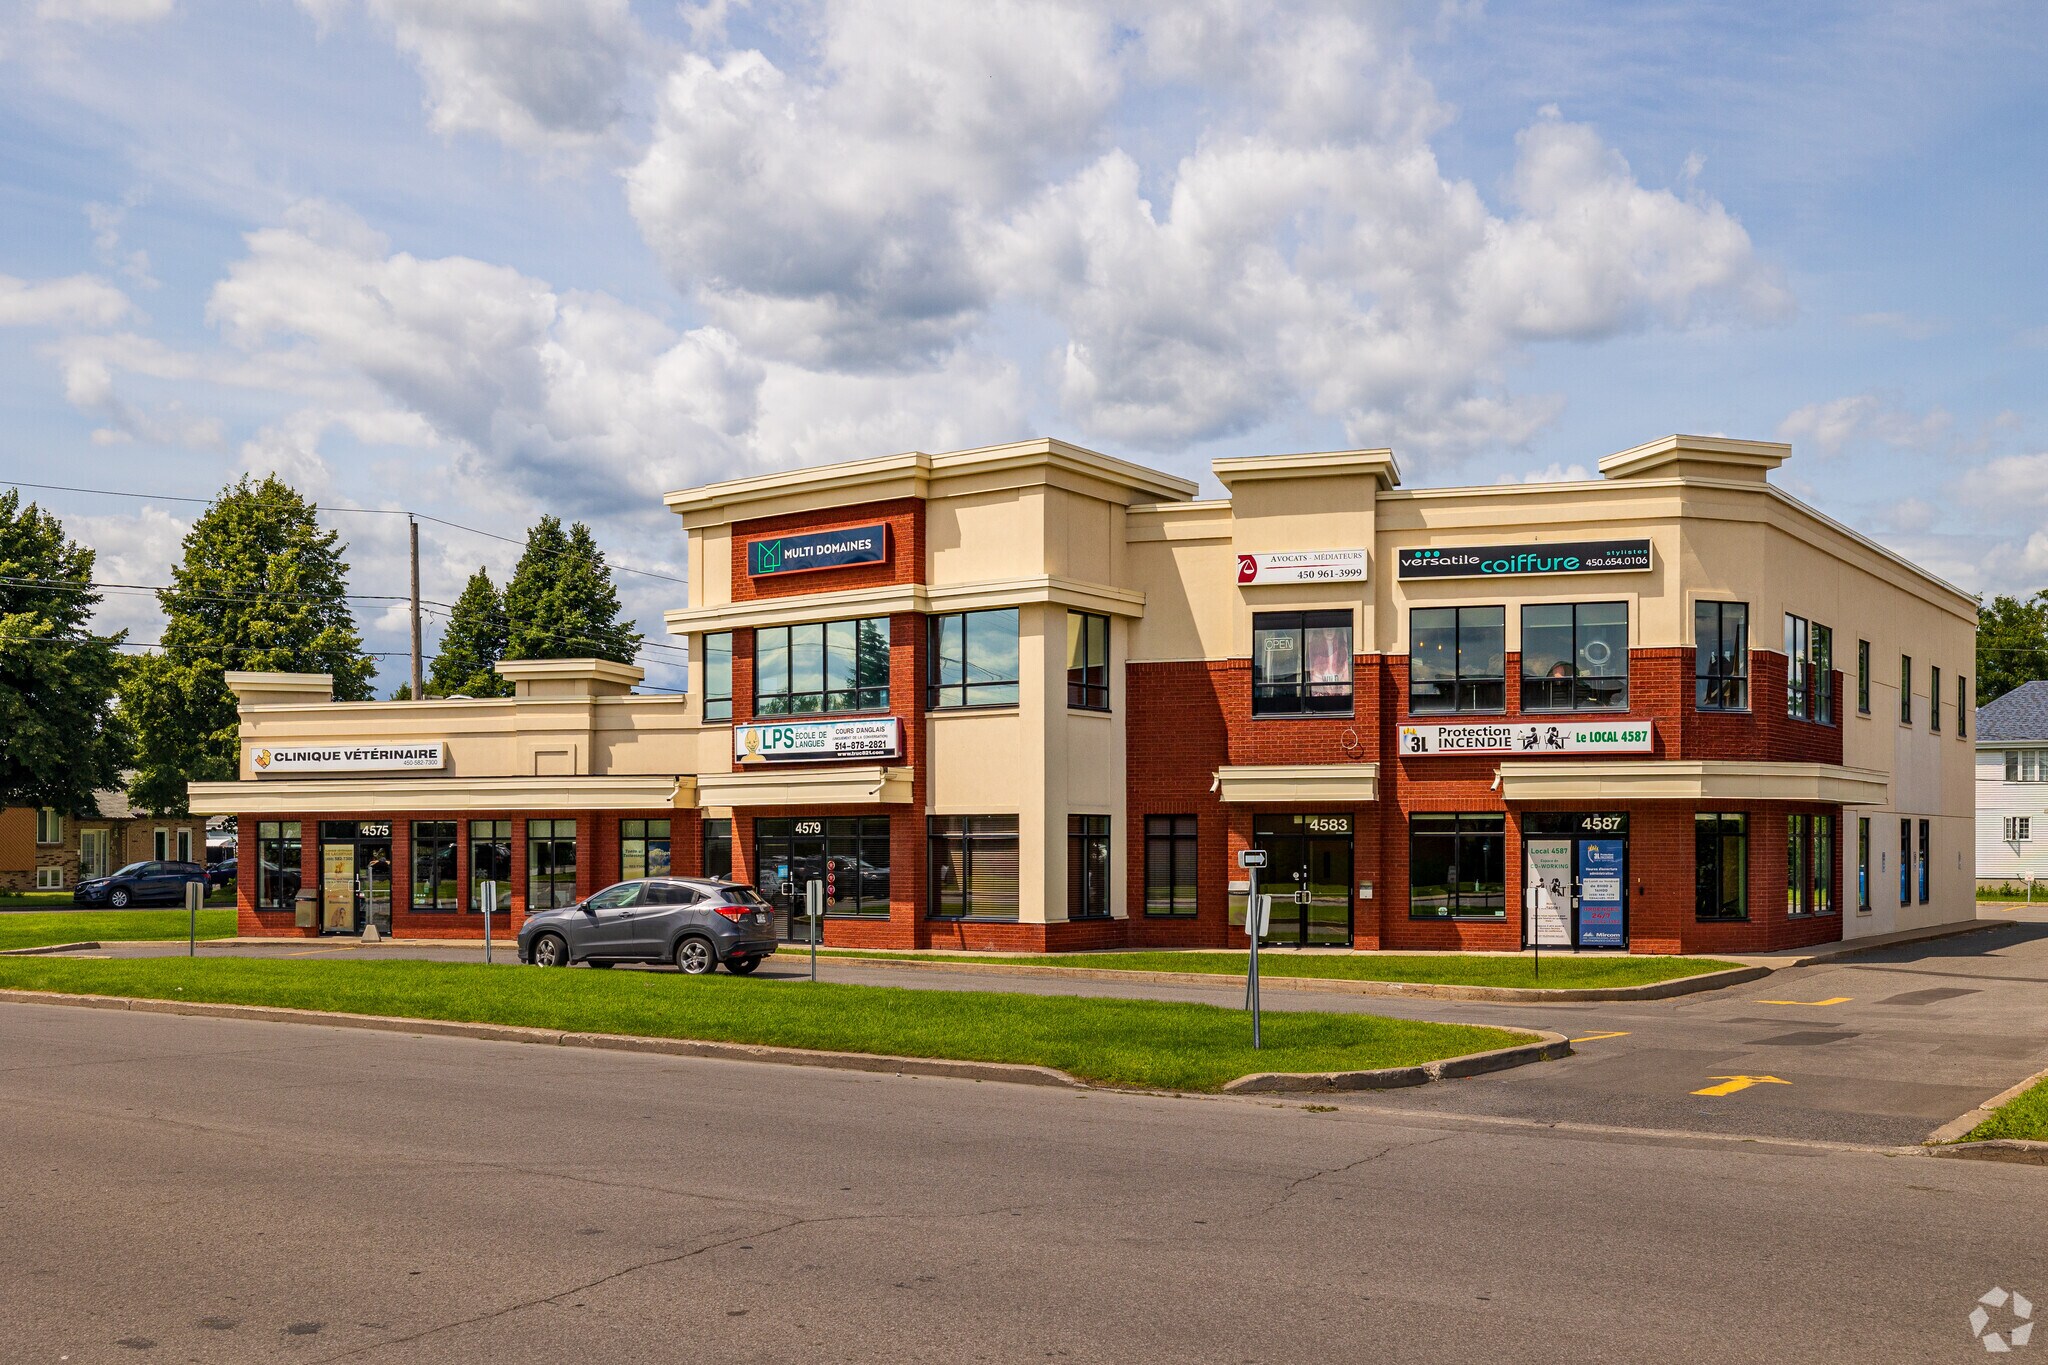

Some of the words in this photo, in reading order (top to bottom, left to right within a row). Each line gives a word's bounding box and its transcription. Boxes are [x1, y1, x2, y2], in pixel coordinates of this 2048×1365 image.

[784, 546, 814, 559] MULTI
[816, 539, 872, 555] DOMAINES
[1270, 555, 1308, 563] AVOCATS
[1314, 552, 1363, 561] MÉDIATEURS
[1401, 554, 1480, 567] versatile
[1480, 553, 1580, 573] coiffure
[1586, 556, 1648, 567] 450.654.0106
[1297, 570, 1314, 579] 450
[1317, 568, 1362, 579] 961-3999
[1266, 639, 1292, 650] OPEN
[1438, 726, 1511, 738] Protection
[1576, 732, 1588, 743] Le
[1589, 730, 1618, 743] LOCAL
[1621, 730, 1648, 742] 4587
[762, 727, 794, 750] LPS
[818, 731, 828, 739] DE
[795, 739, 825, 749] LANGUES
[1411, 736, 1428, 752] 3L
[1438, 736, 1512, 748] INCENDIE
[834, 740, 886, 750] 514-878-2821
[274, 751, 341, 762] CLINIQUE
[344, 748, 438, 761] VÉTÉRINAIRE
[795, 822, 822, 834] 4579
[1310, 818, 1348, 831] 4583
[1582, 818, 1622, 830] 4587
[362, 825, 389, 836] 4575
